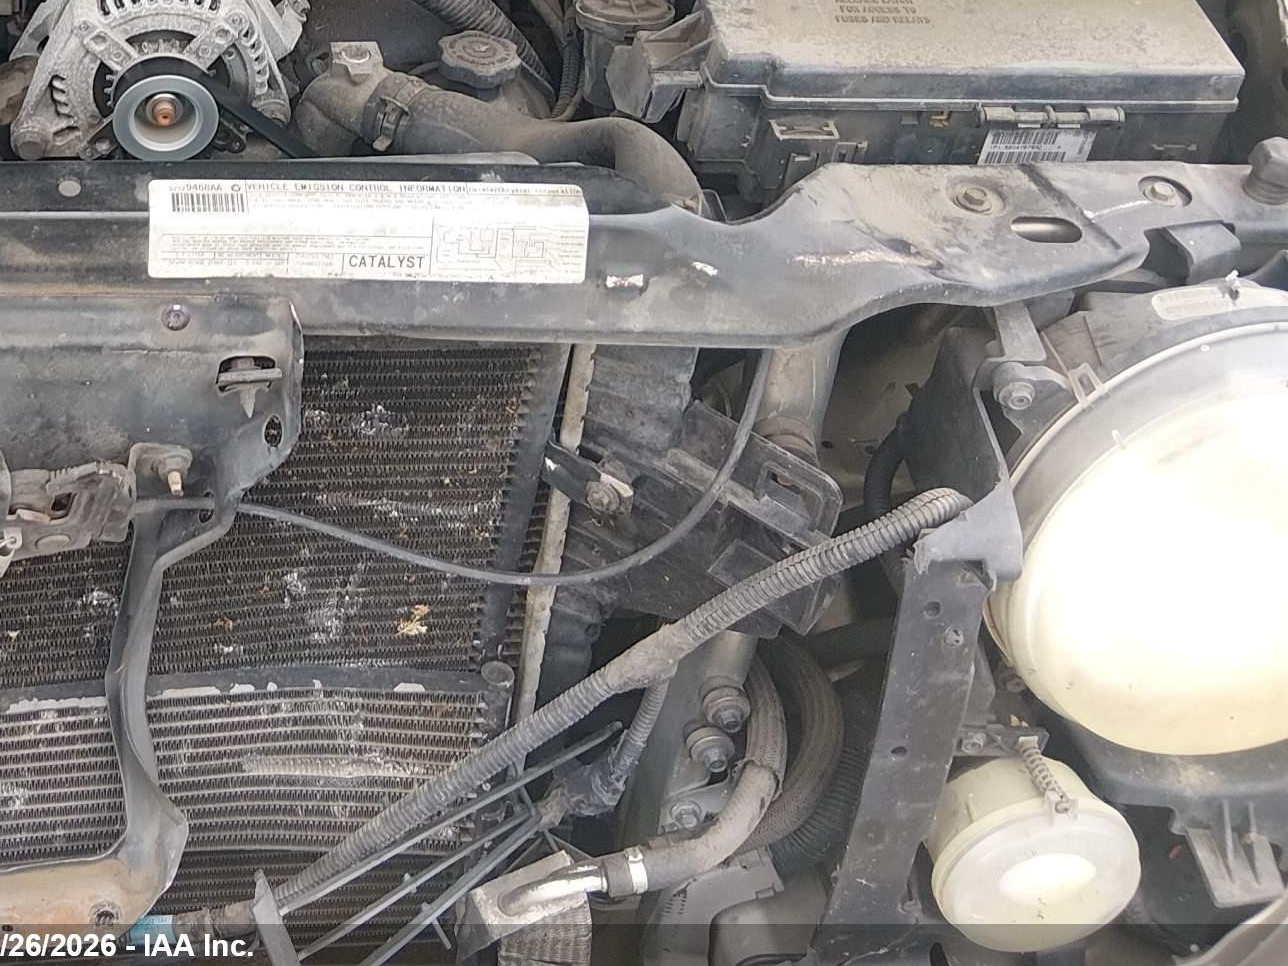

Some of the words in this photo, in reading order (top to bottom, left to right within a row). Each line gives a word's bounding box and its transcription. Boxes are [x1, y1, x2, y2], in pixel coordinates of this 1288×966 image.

[246, 183, 289, 192] VEHICLE
[294, 183, 344, 192] EMISSION
[349, 184, 392, 193] CONTROL
[399, 185, 466, 194] INFORMATION
[348, 254, 426, 270] CATALYST
